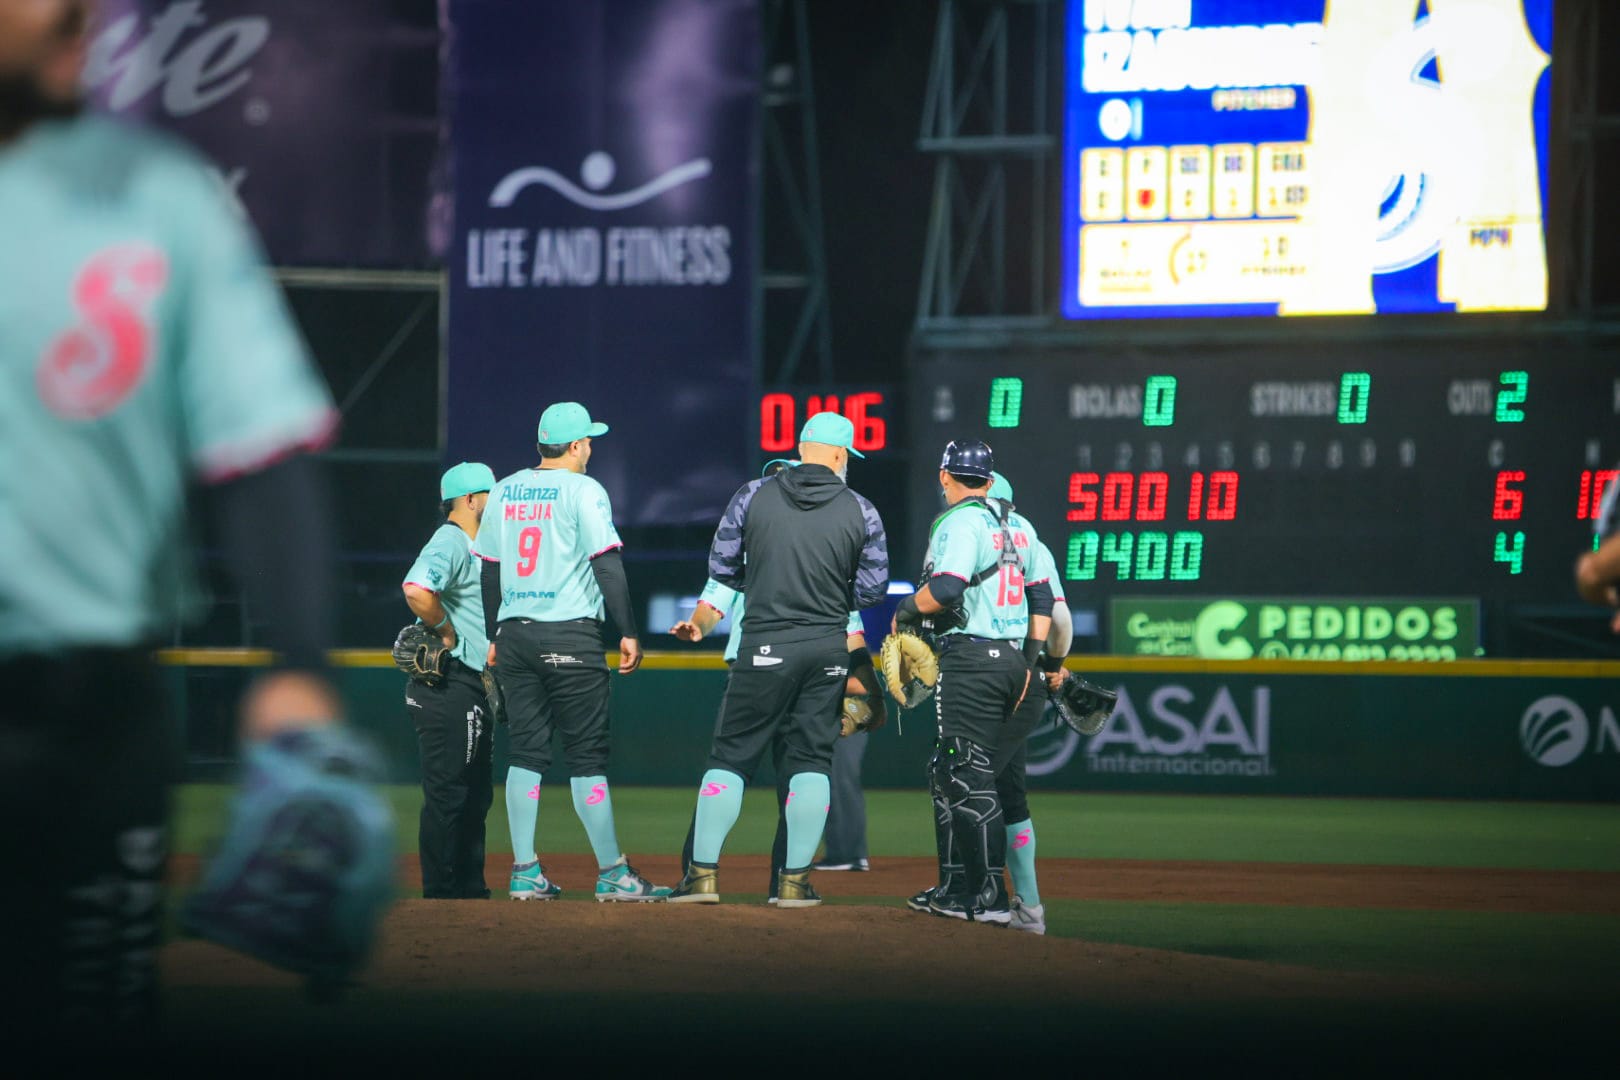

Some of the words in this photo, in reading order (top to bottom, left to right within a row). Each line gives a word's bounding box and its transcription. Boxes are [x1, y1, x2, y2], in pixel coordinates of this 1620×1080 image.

[467, 228, 528, 287] LIFE
[532, 228, 599, 287] AND
[606, 225, 732, 286] FITNESS
[989, 377, 1023, 428] 0
[1069, 384, 1142, 418] BOLAS
[1143, 375, 1177, 426] 0
[1250, 381, 1336, 416] STRIKES
[1337, 372, 1371, 424] 0
[1447, 379, 1492, 416] OUTS
[1496, 371, 1529, 422] 2
[500, 484, 560, 502] Alianza
[505, 504, 552, 521] MEJIA
[1493, 469, 1527, 521] 6
[516, 526, 542, 578] 9
[1494, 530, 1526, 575] 4
[1258, 605, 1458, 641] PEDIDOS
[1087, 684, 1272, 755] ASAI
